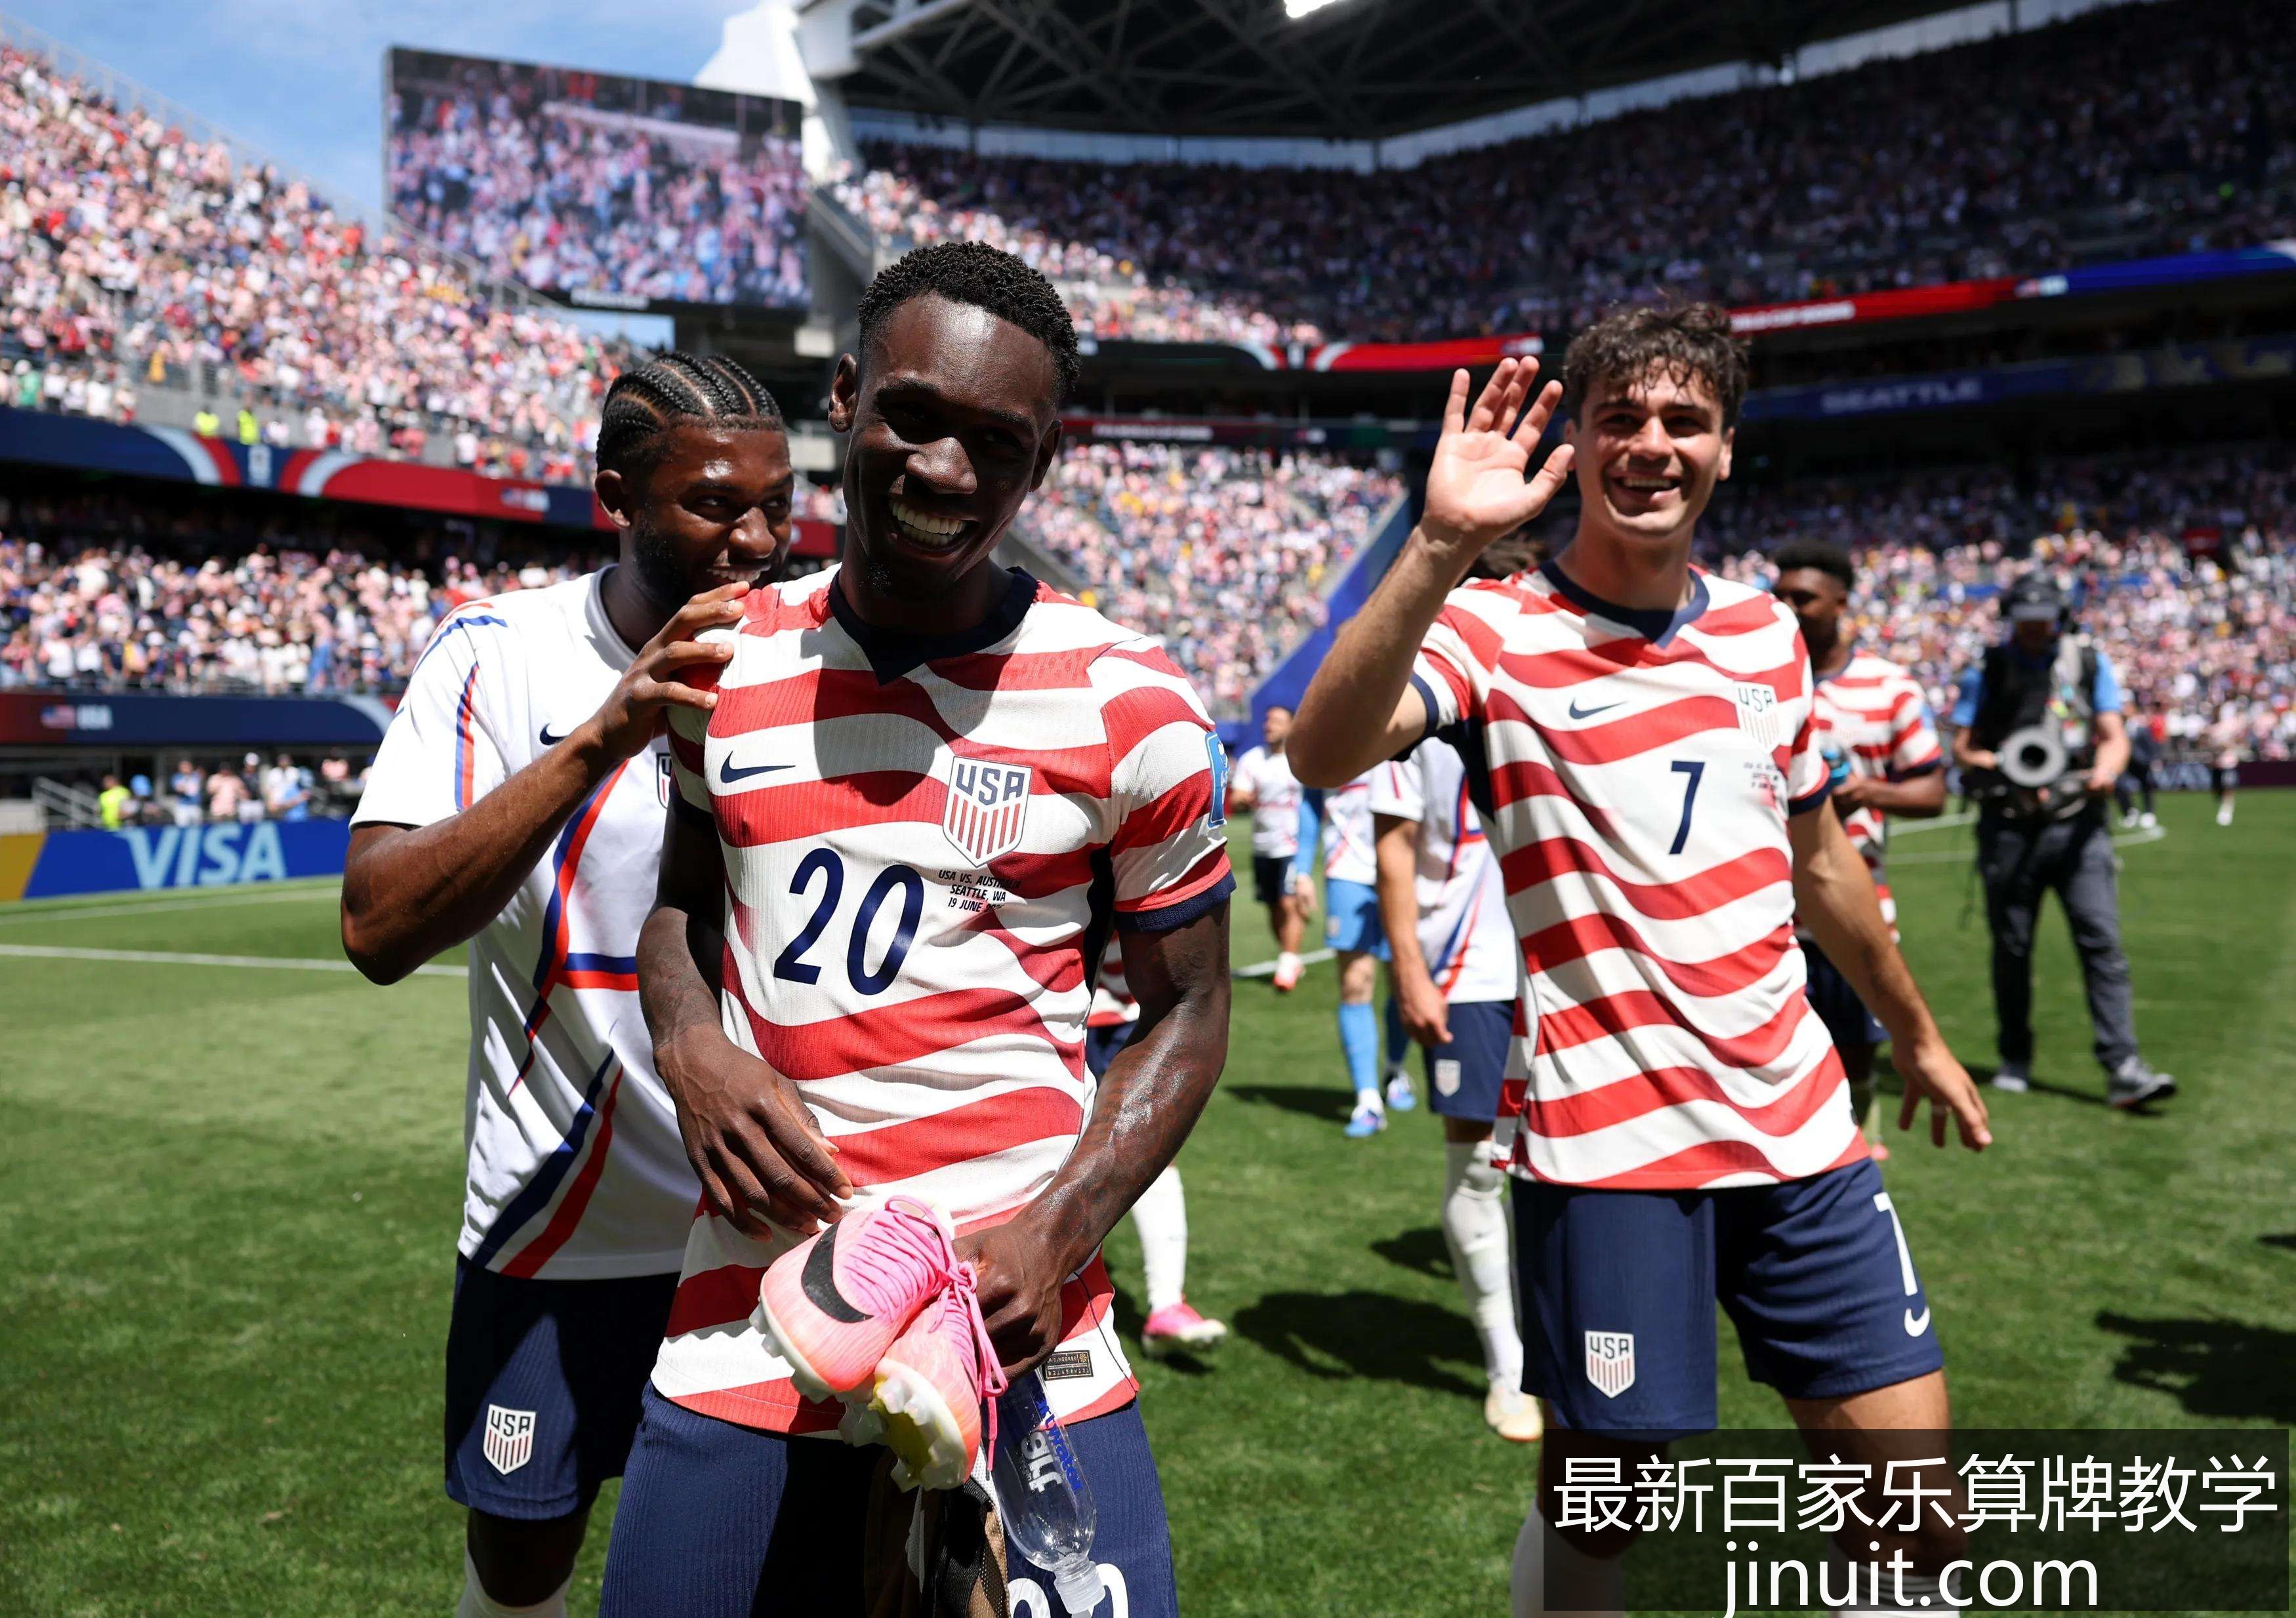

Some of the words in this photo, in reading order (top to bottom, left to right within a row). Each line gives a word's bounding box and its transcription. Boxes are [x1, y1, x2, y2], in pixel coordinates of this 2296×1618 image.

[1738, 687, 1773, 712] USA
[956, 763, 1025, 805] USA
[1669, 761, 1705, 855] 7
[114, 821, 287, 889] VISA
[938, 869, 956, 881] USA
[959, 873, 972, 884] VS.
[948, 897, 957, 908] 19
[958, 899, 983, 912] JUNE
[950, 884, 989, 902] SEATTLE,
[993, 891, 1006, 902] WA
[773, 848, 924, 995] 20
[1590, 1336, 1629, 1359] USA
[491, 1409, 531, 1437] USA
